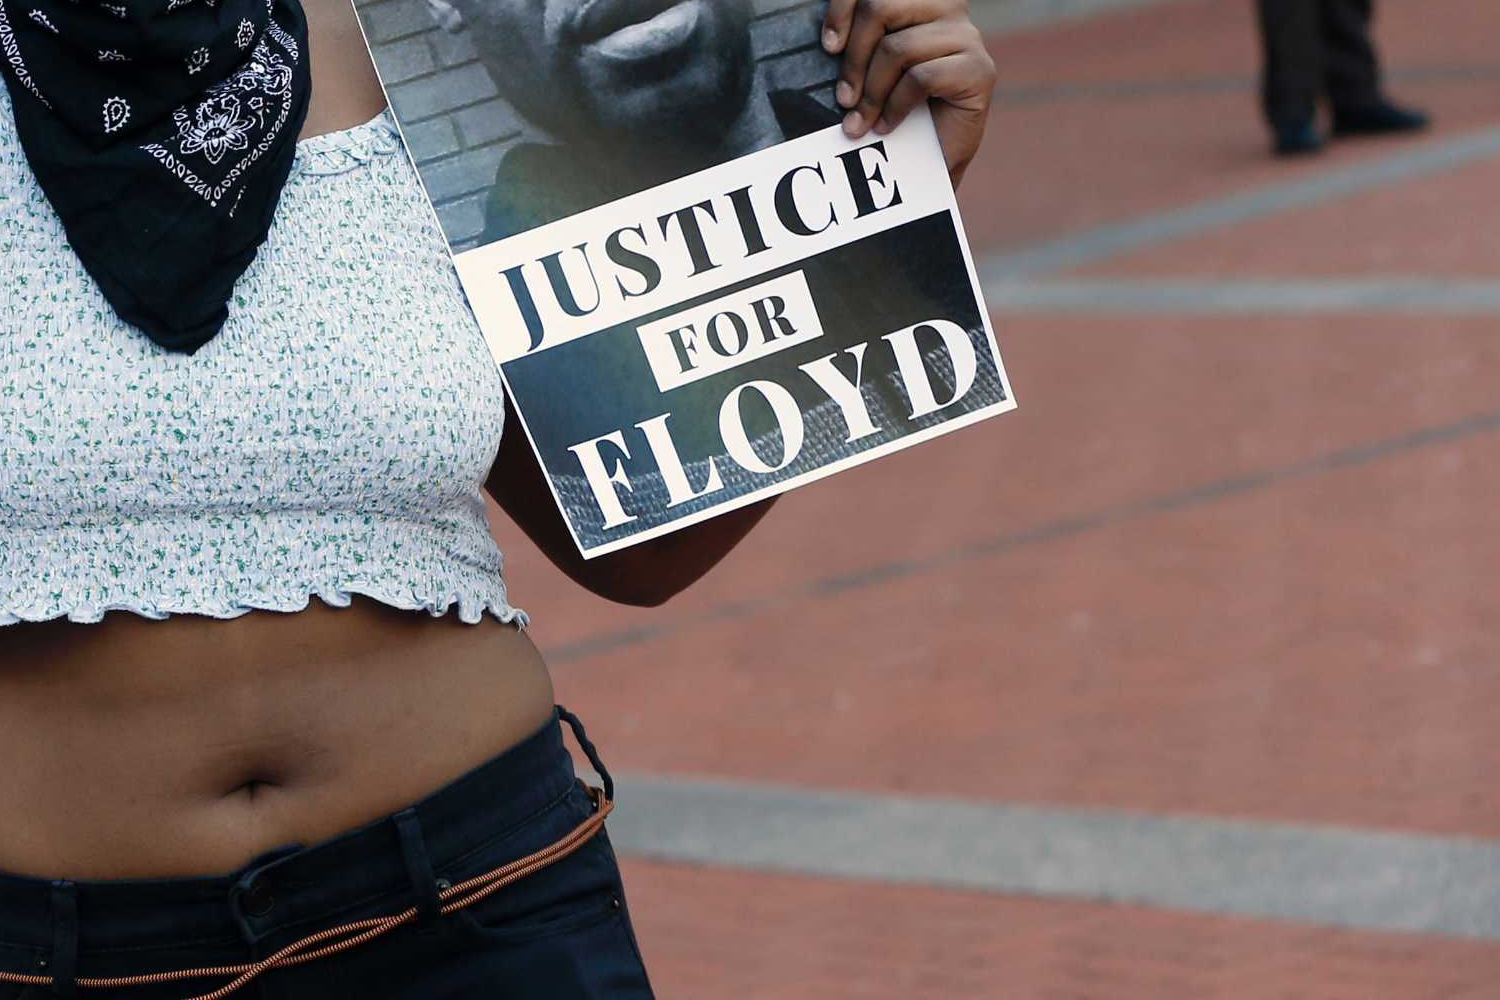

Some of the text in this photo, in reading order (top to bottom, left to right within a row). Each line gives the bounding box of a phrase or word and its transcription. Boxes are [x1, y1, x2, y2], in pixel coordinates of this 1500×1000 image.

[498, 140, 903, 353] JUSTICE
[664, 295, 799, 374] FOR
[567, 319, 978, 531] FLOYD
